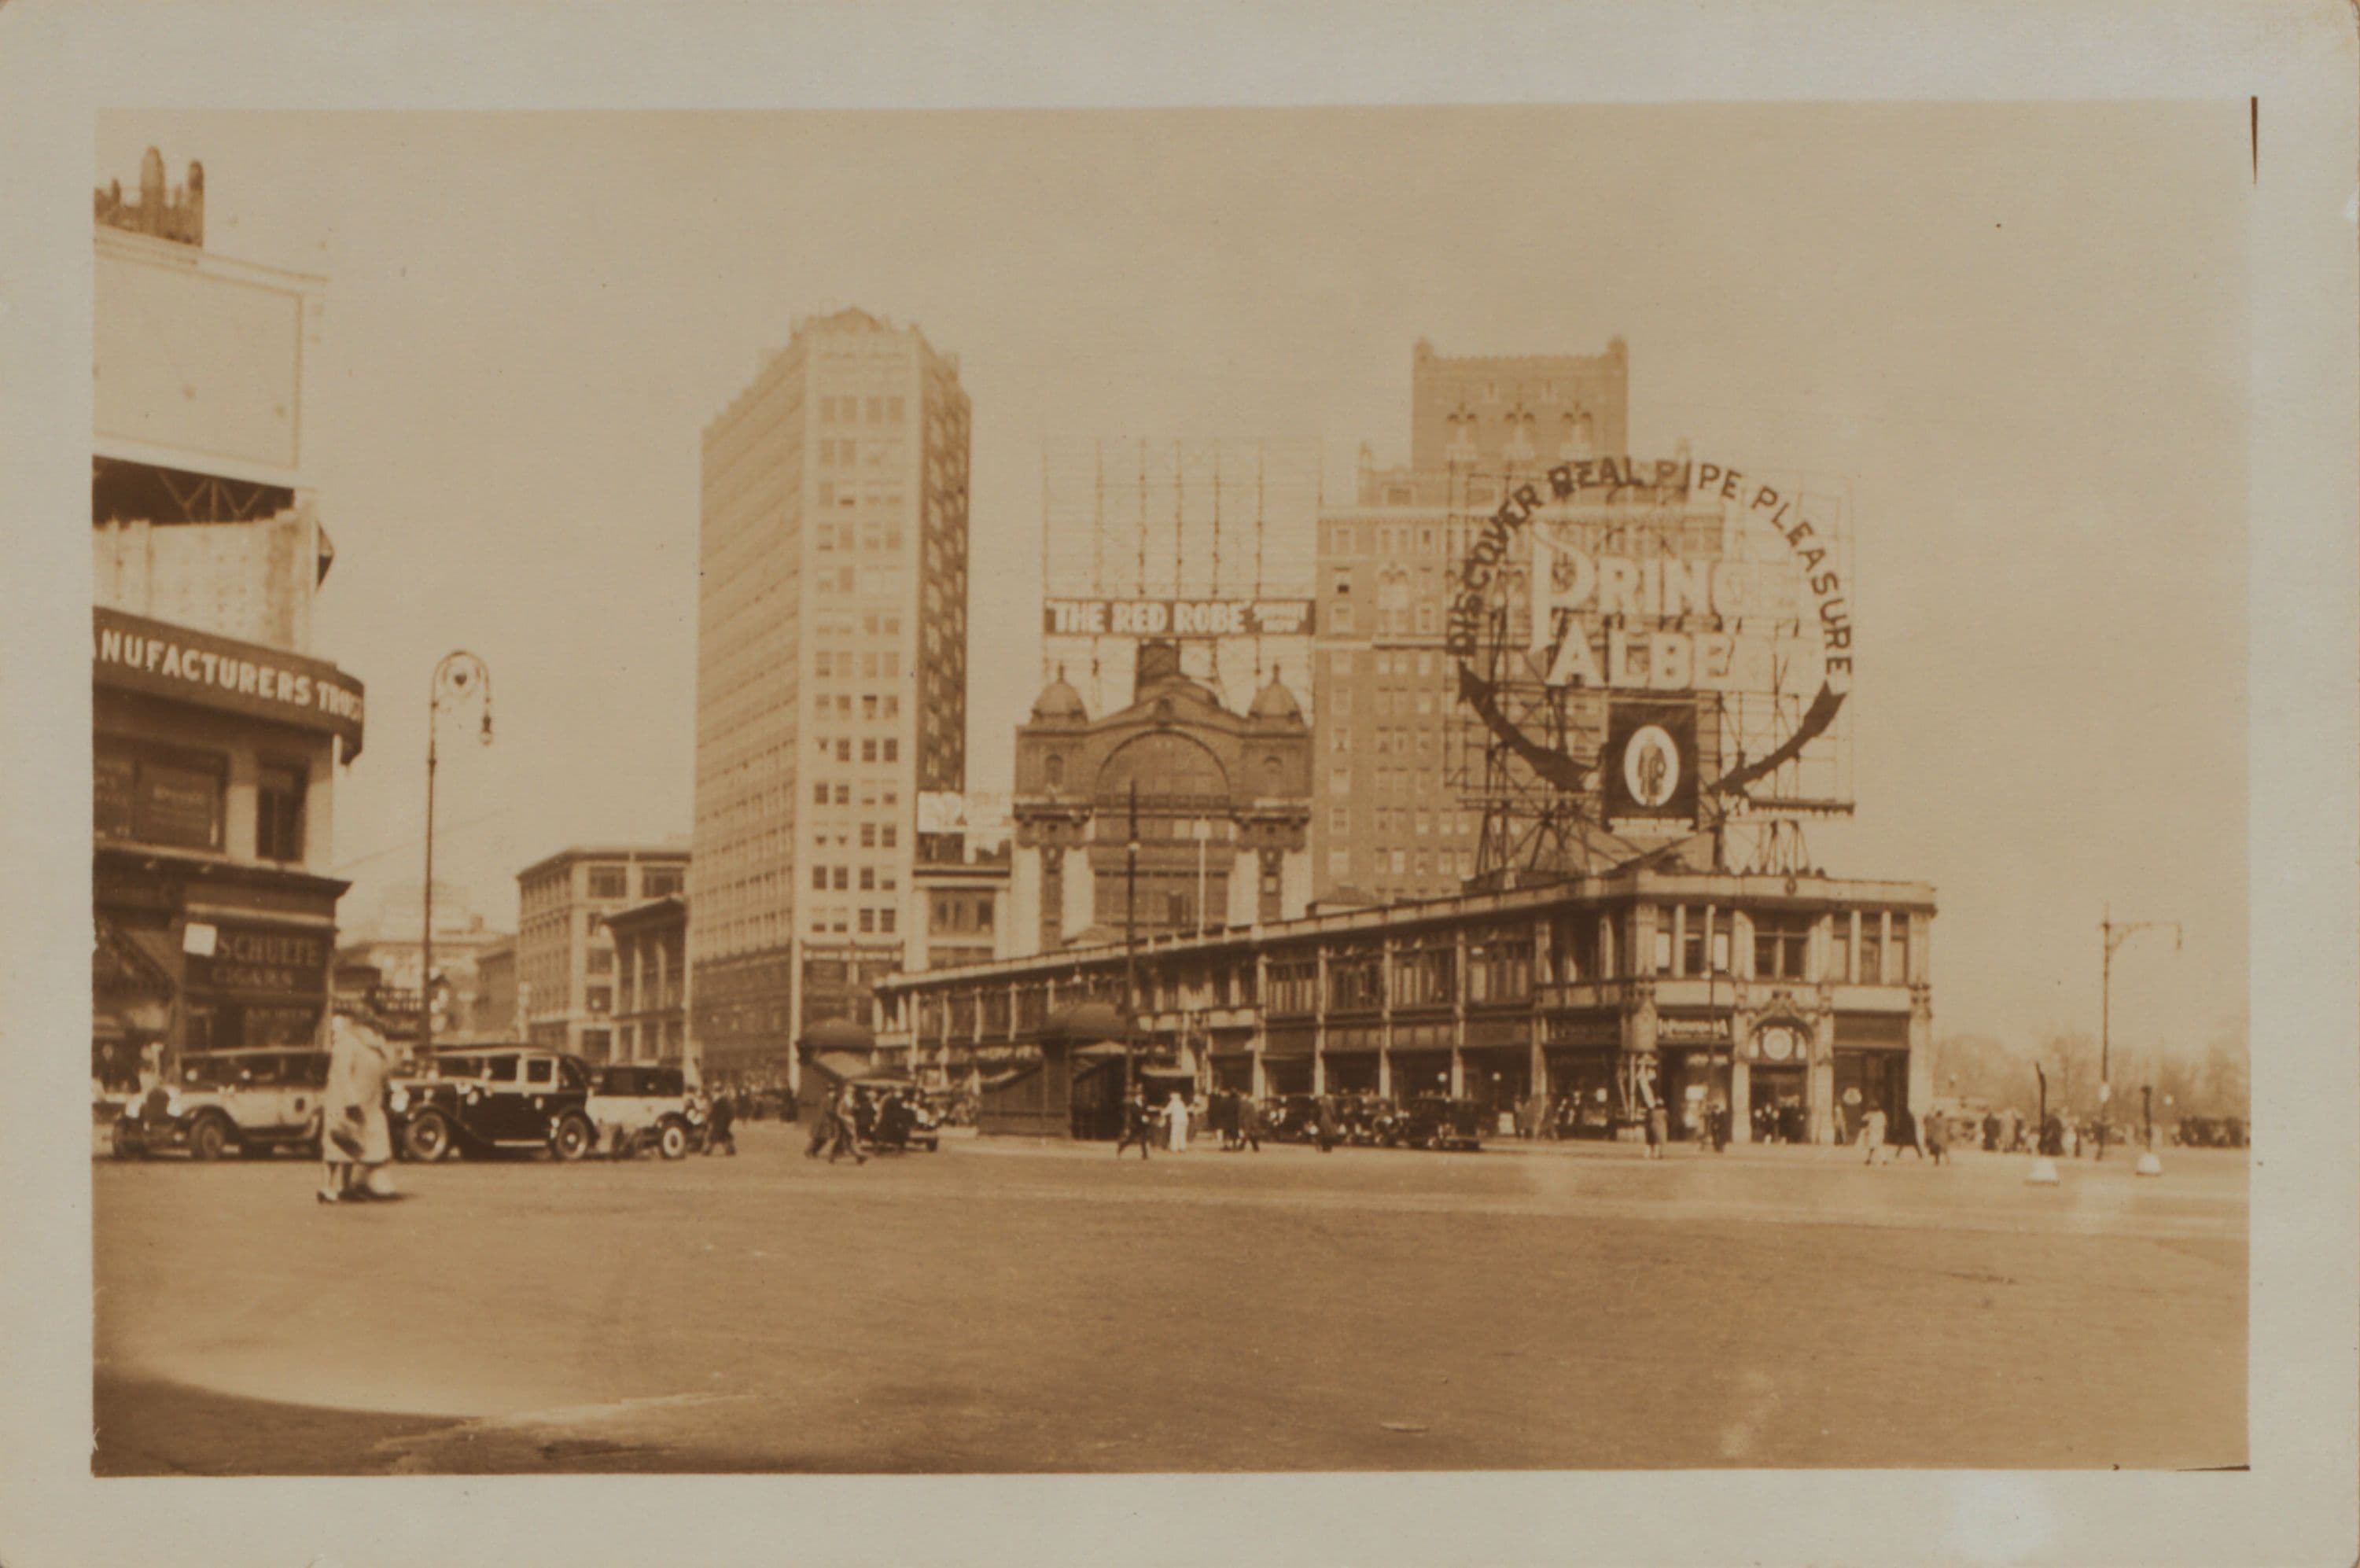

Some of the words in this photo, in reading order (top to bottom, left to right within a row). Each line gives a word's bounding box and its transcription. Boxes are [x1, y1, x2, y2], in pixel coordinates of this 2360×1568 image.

[1446, 484, 1543, 656] DISCOVER
[1548, 456, 1644, 497] REAL
[1655, 459, 1741, 499] PIPE
[1751, 486, 1852, 675] PLEASURE
[1112, 602, 1168, 634] RED
[93, 629, 312, 705] NUFACTURERS
